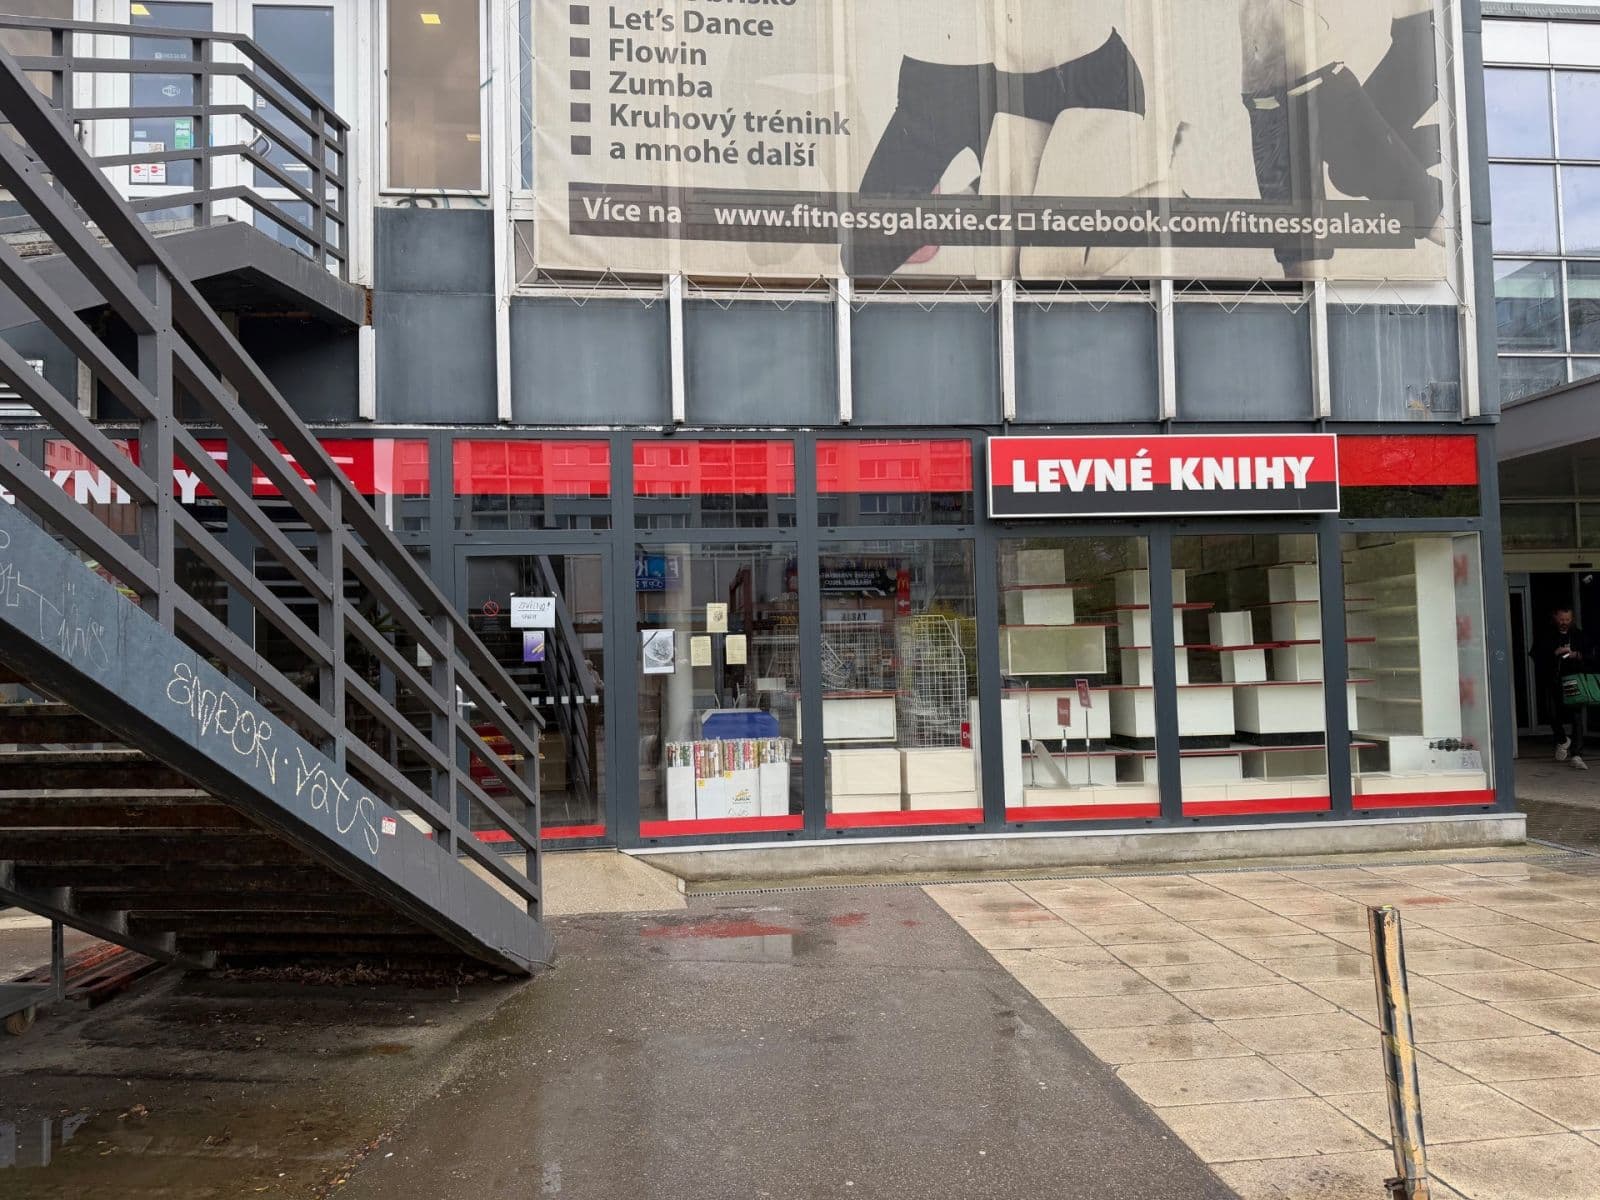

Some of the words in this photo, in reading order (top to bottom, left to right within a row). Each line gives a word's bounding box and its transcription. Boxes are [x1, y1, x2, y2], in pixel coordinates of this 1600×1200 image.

[609, 6, 674, 32] Let's
[684, 10, 774, 36] Dance
[609, 38, 707, 65] Flowin
[609, 71, 712, 98] Zumba
[610, 103, 736, 138] Kruhový
[744, 109, 850, 135] trénink
[609, 141, 626, 160] a
[635, 138, 738, 164] mnohé
[747, 141, 816, 167] další
[583, 197, 640, 221] Více
[649, 204, 682, 223] na
[714, 203, 1012, 235] www.fitnessgalaxie.cz
[1042, 208, 1401, 240] facebook.com/fitnessgalaxie
[1012, 448, 1154, 493] LEVNÉ
[1170, 456, 1315, 491] KNIHY
